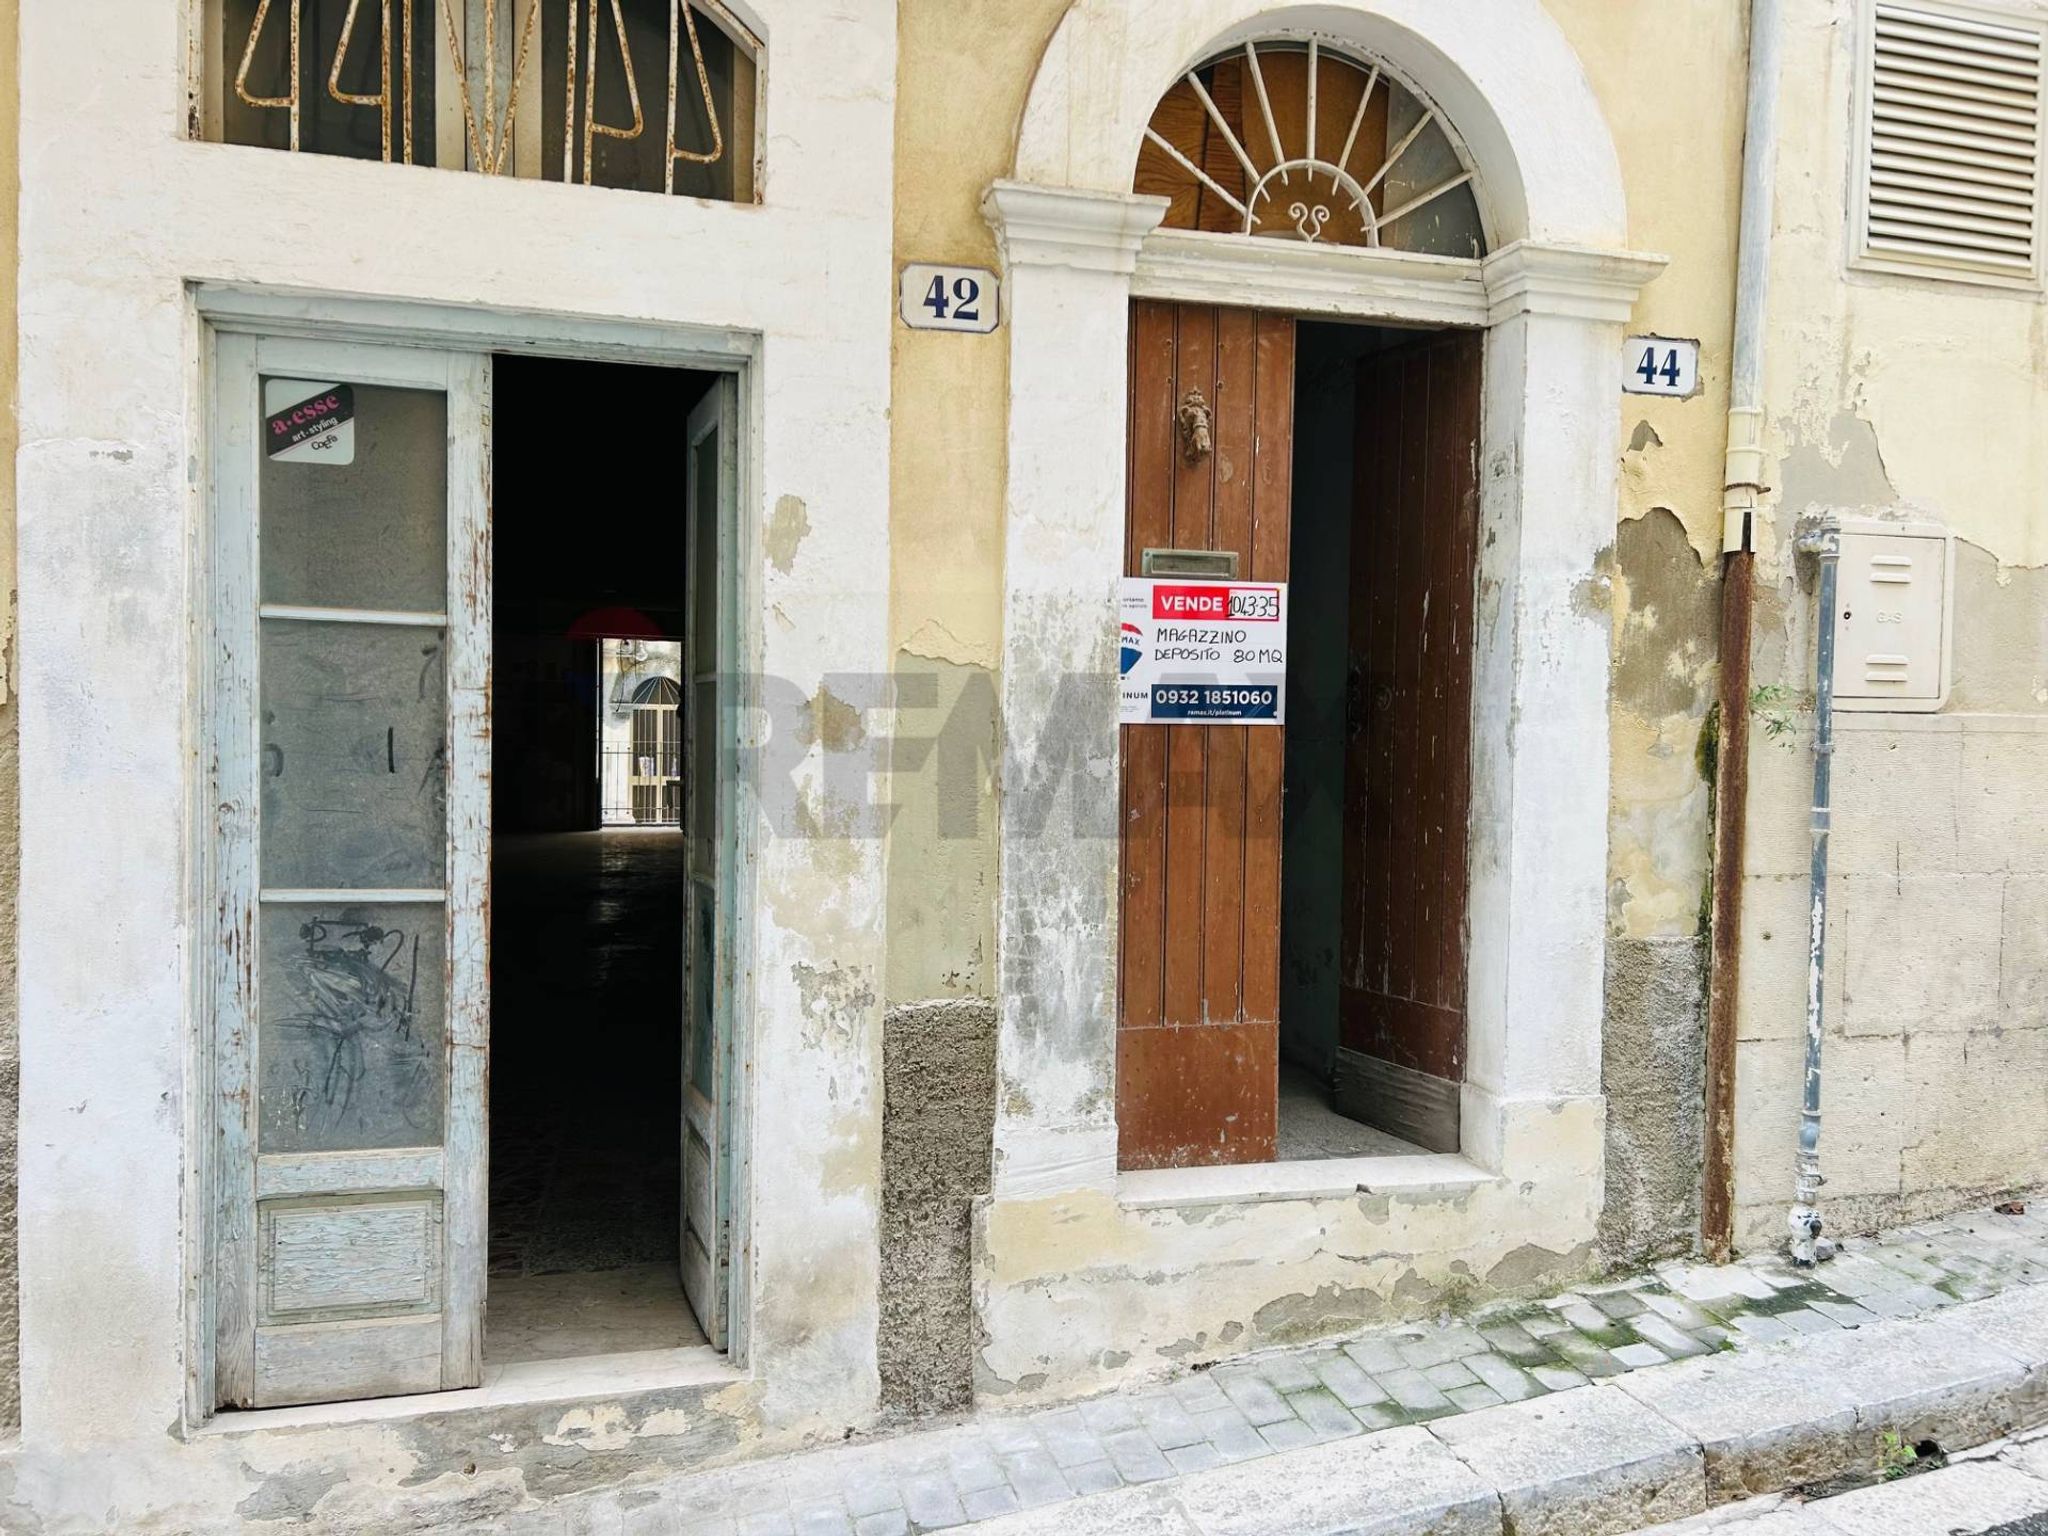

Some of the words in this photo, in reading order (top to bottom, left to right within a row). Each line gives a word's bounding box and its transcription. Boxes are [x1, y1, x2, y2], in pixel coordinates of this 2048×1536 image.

[923, 275, 979, 320] 42
[1636, 346, 1681, 387] 44
[1160, 595, 1224, 612] VENDE
[1156, 628, 1247, 645] MAGAZZINO
[1154, 647, 1221, 661] DEPOSITO
[1233, 649, 1256, 663] 80
[1258, 649, 1283, 663] MQ
[1155, 689, 1199, 705] 0932
[1203, 690, 1272, 705] 1851060
